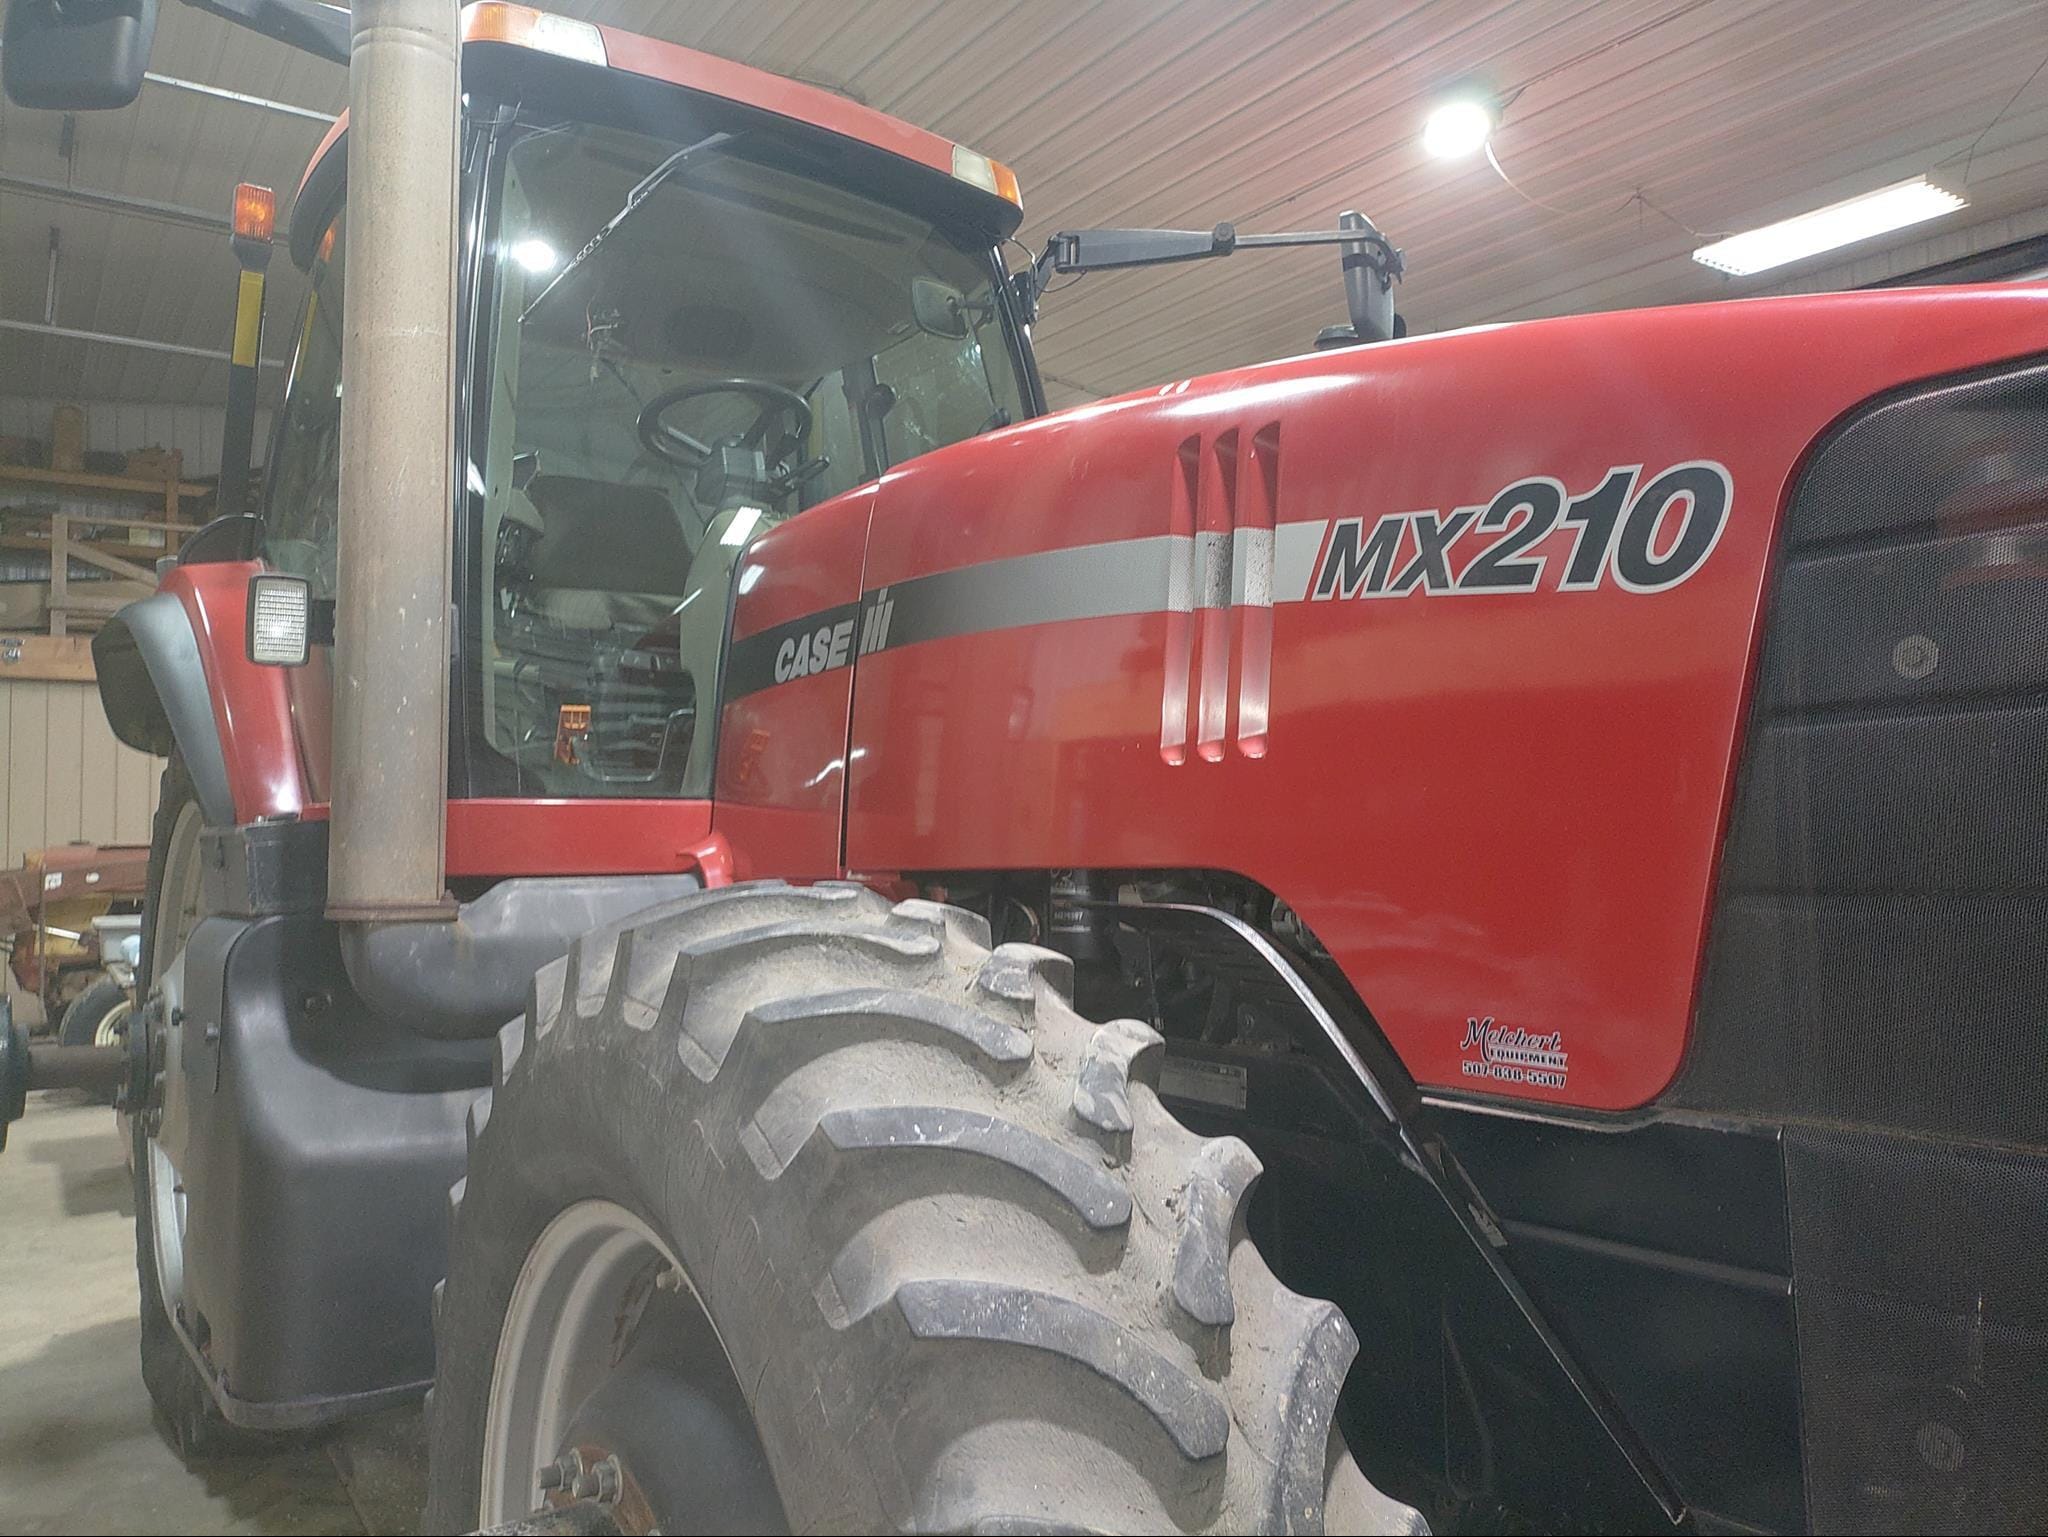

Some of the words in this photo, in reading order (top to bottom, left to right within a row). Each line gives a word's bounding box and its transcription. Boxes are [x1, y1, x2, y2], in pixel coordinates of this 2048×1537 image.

[1312, 460, 1734, 601] MX210
[774, 619, 854, 684] CASE
[1460, 1016, 1562, 1062] Melchert
